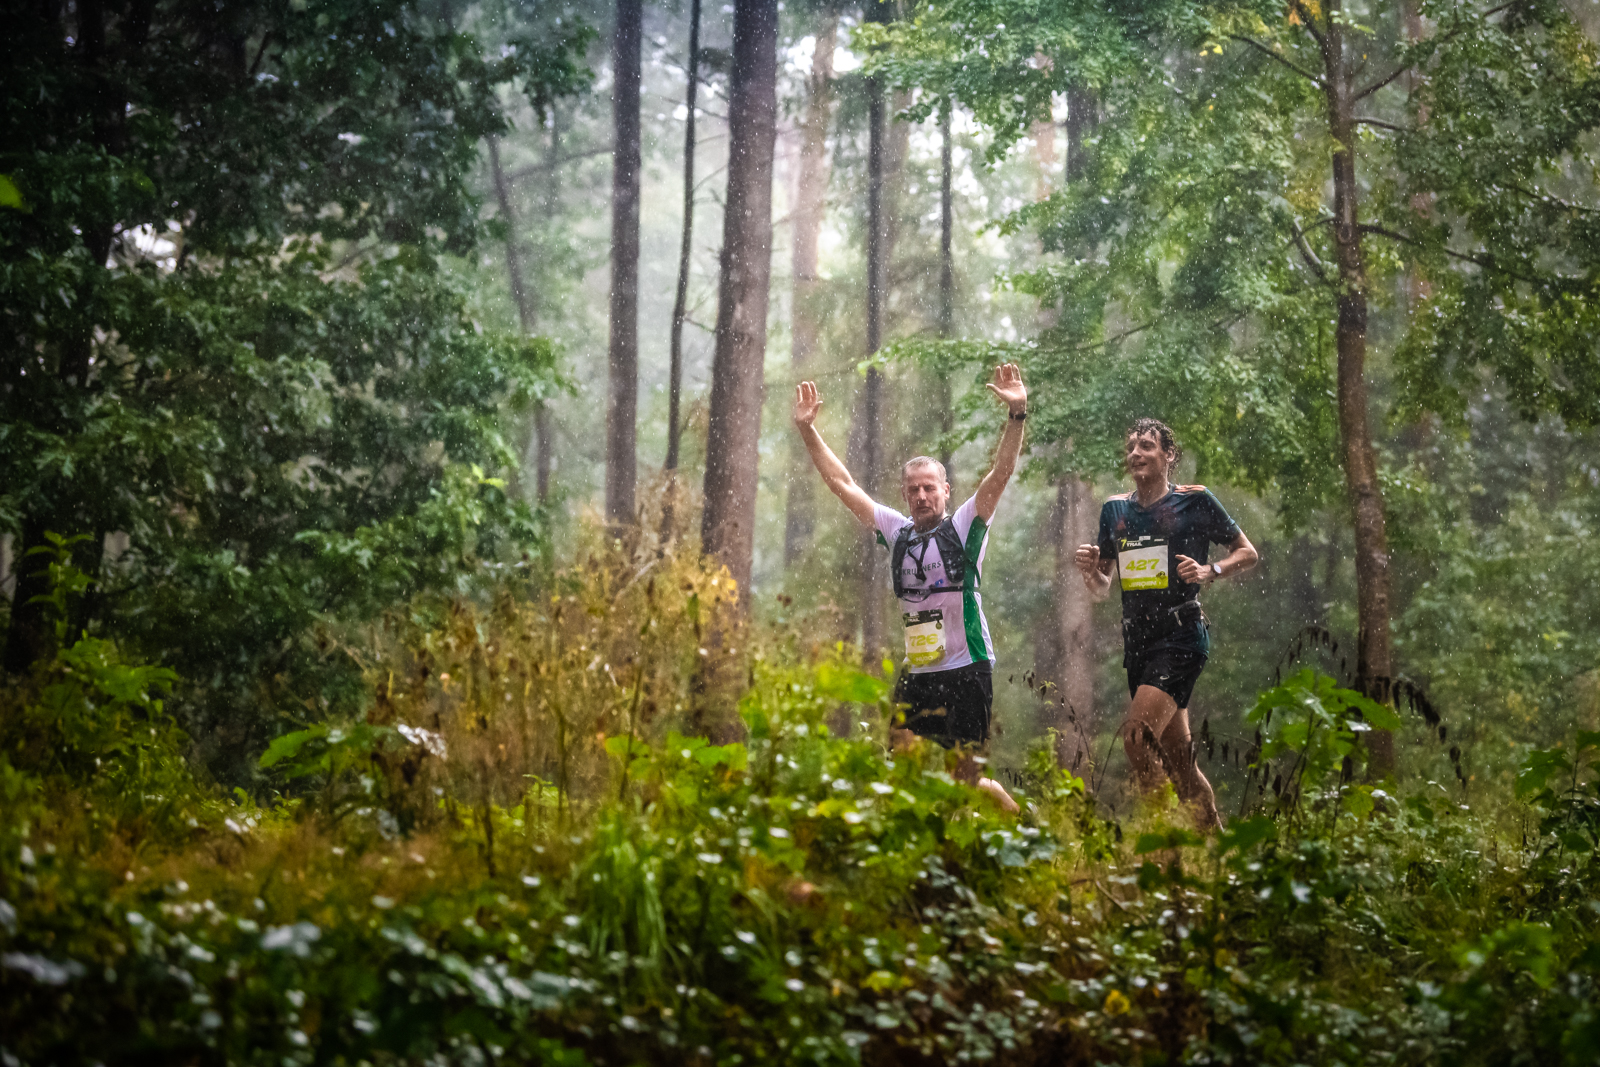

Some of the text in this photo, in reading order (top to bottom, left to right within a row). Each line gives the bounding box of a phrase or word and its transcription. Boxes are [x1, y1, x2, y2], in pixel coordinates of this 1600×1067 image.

[1120, 538, 1127, 549] 7
[902, 560, 942, 576] KRUNERS
[1125, 558, 1160, 571] 427
[909, 633, 938, 647] 726
